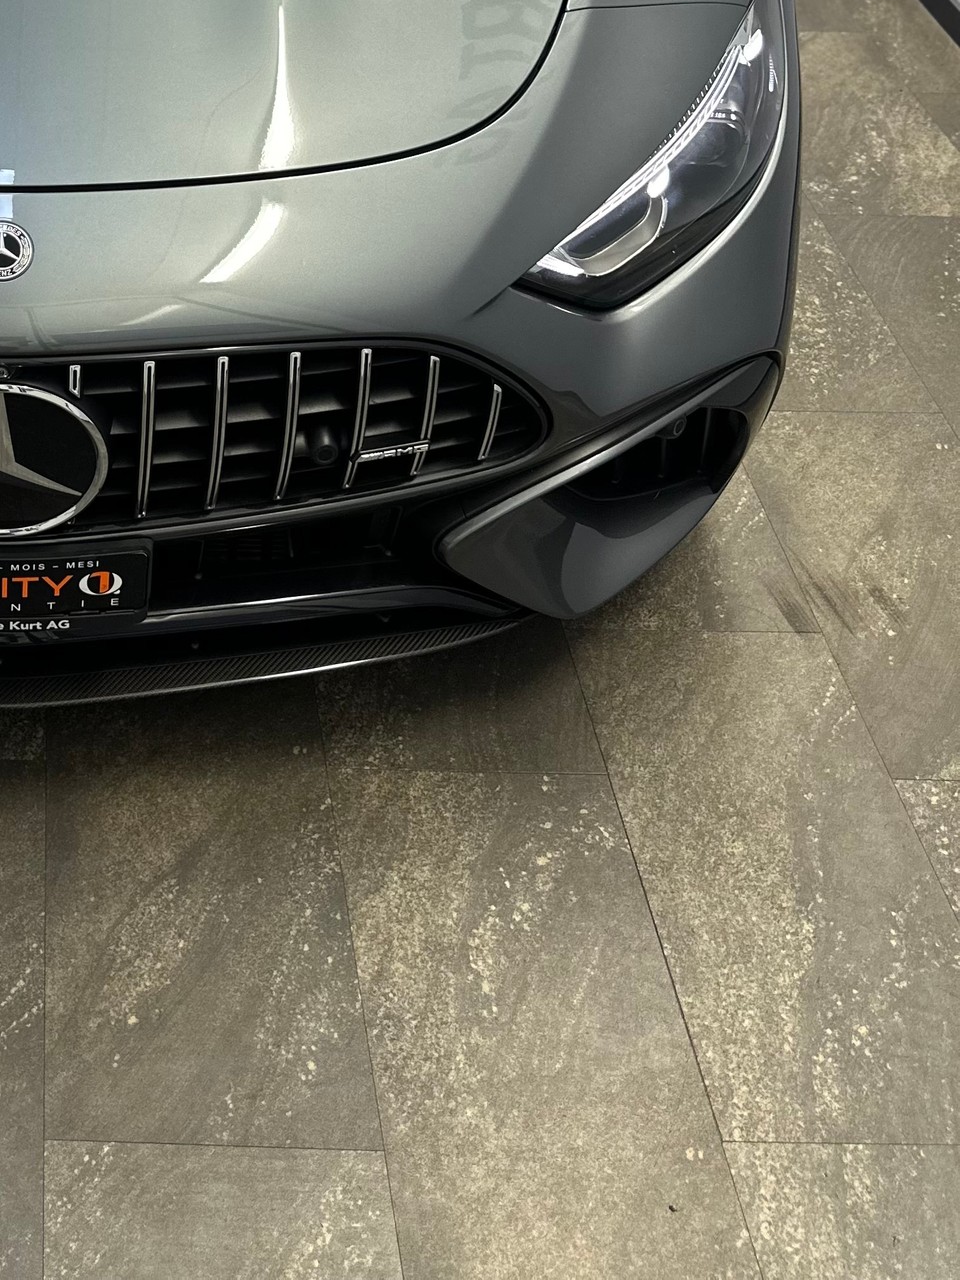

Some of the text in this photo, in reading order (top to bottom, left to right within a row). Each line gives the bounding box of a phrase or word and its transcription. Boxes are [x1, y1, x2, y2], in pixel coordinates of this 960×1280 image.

[10, 563, 46, 571] MOIS
[66, 560, 100, 569] MESI
[9, 620, 43, 631] Kurt
[46, 619, 70, 630] AG
